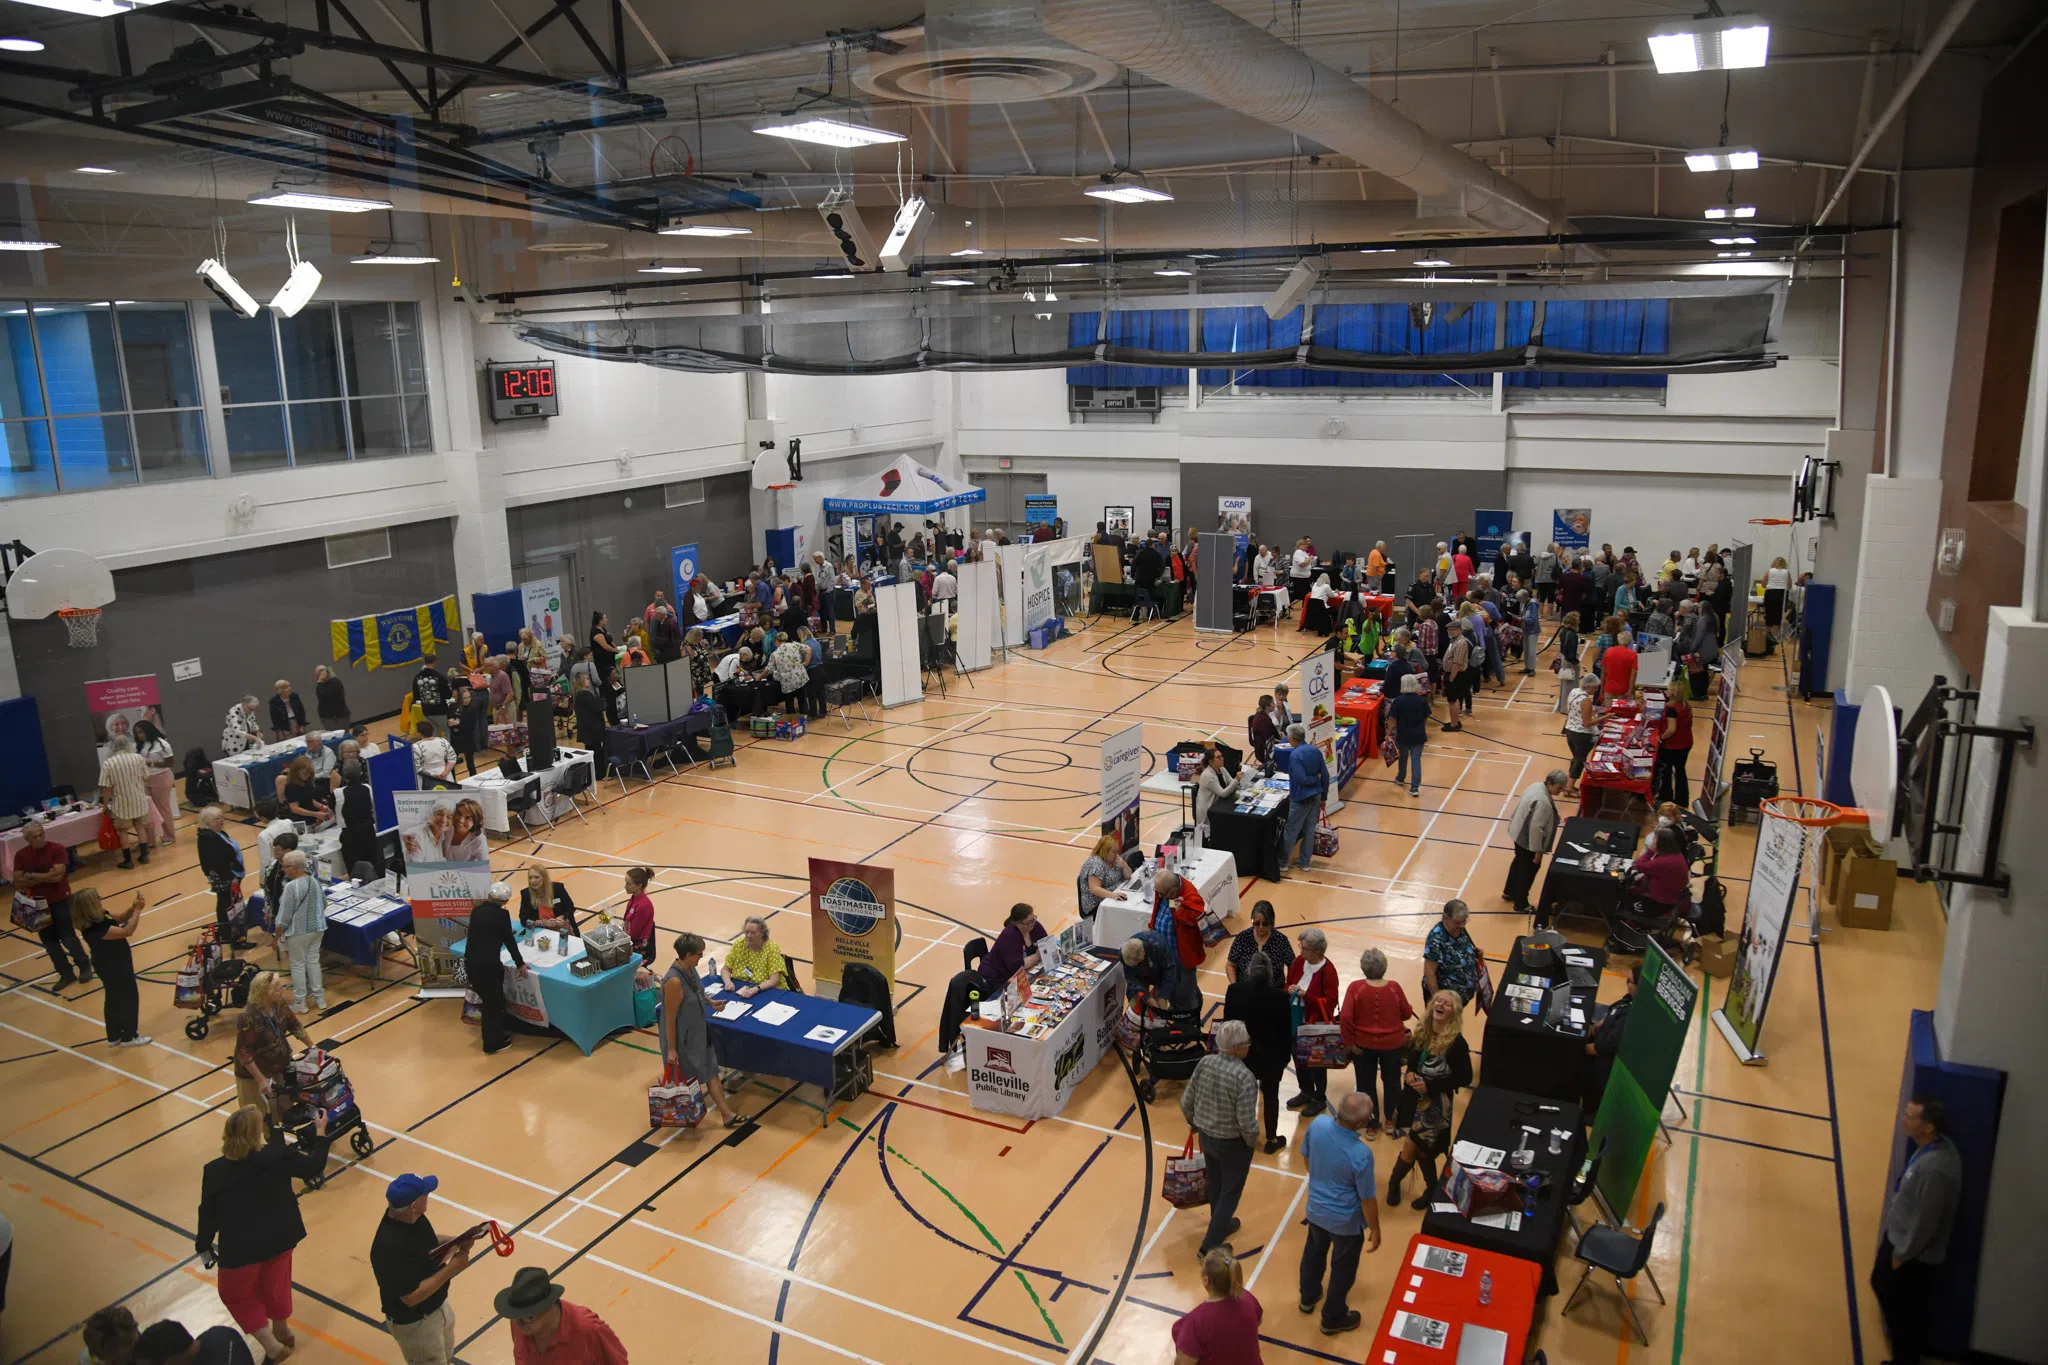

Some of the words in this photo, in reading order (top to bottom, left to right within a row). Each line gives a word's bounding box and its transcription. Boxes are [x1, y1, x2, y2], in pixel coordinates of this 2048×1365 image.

[504, 369, 553, 398] 12:08
[828, 500, 920, 511] WWW.PROPLUSTECH.COM
[958, 493, 979, 504] TECH
[1224, 500, 1245, 508] CARP
[1027, 587, 1050, 609] HOSPICE
[1308, 672, 1329, 696] CDC
[1113, 746, 1140, 765] caregiver
[430, 886, 471, 899] Livita
[821, 896, 884, 912] TOASTMASTERS
[828, 904, 877, 917] INTERNATIONAL
[835, 936, 871, 948] BELLEVILLE
[836, 944, 869, 954] SPEAK-EASY
[833, 948, 874, 961] TOASTMASTERS
[1658, 972, 1685, 1007] HEARING
[1661, 963, 1693, 1002] CANADIAN
[1656, 982, 1686, 1021] SERVICES
[971, 1068, 1030, 1093] Belleville
[975, 1083, 999, 1095] Public
[1000, 1087, 1026, 1102] Library
